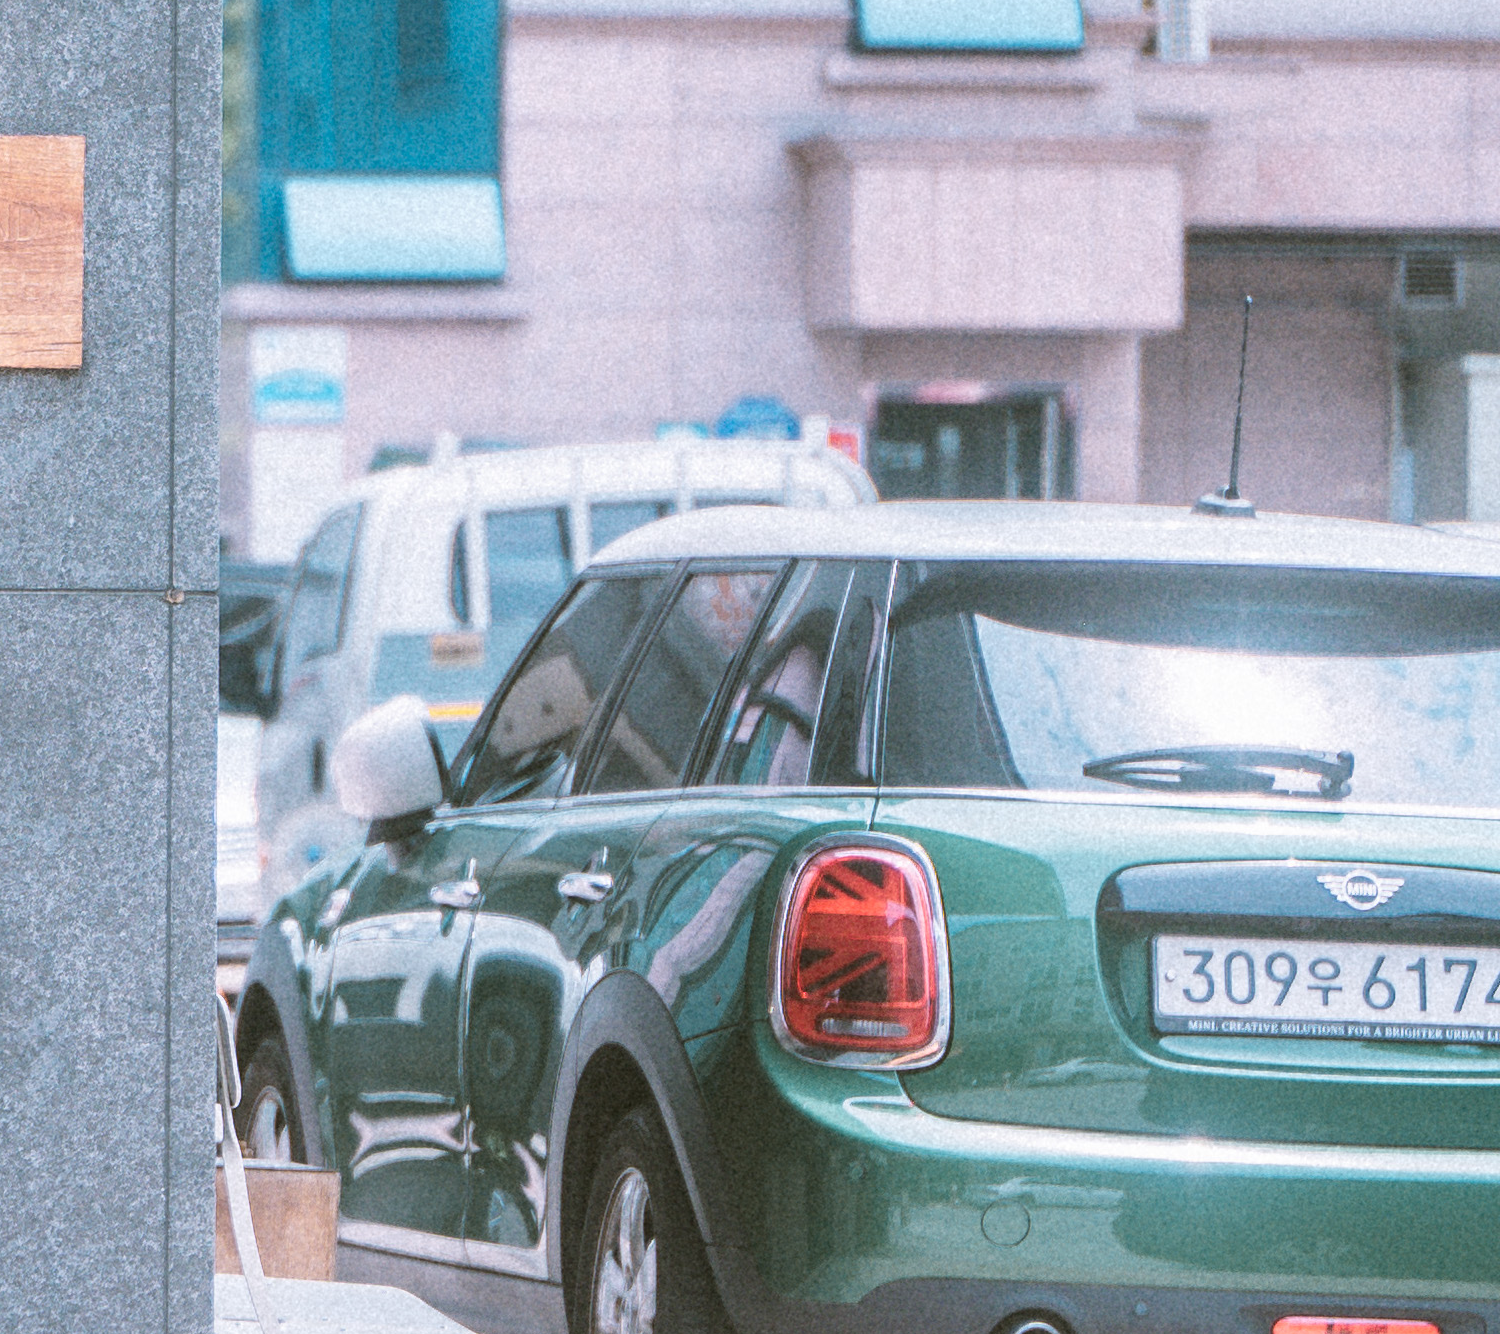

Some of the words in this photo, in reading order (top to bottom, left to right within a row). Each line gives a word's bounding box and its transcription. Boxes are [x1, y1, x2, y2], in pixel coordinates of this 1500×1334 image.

[1346, 881, 1378, 897] MINI
[1181, 948, 1343, 1007] 309우
[1221, 1020, 1279, 1035] CREATIVE
[1281, 1022, 1346, 1036] SOLUTIONS
[1347, 1025, 1371, 1038] FOR
[1373, 1026, 1383, 1038] A
[1384, 1026, 1444, 1040] BRIGHTER
[1445, 1028, 1485, 1042] URBAN
